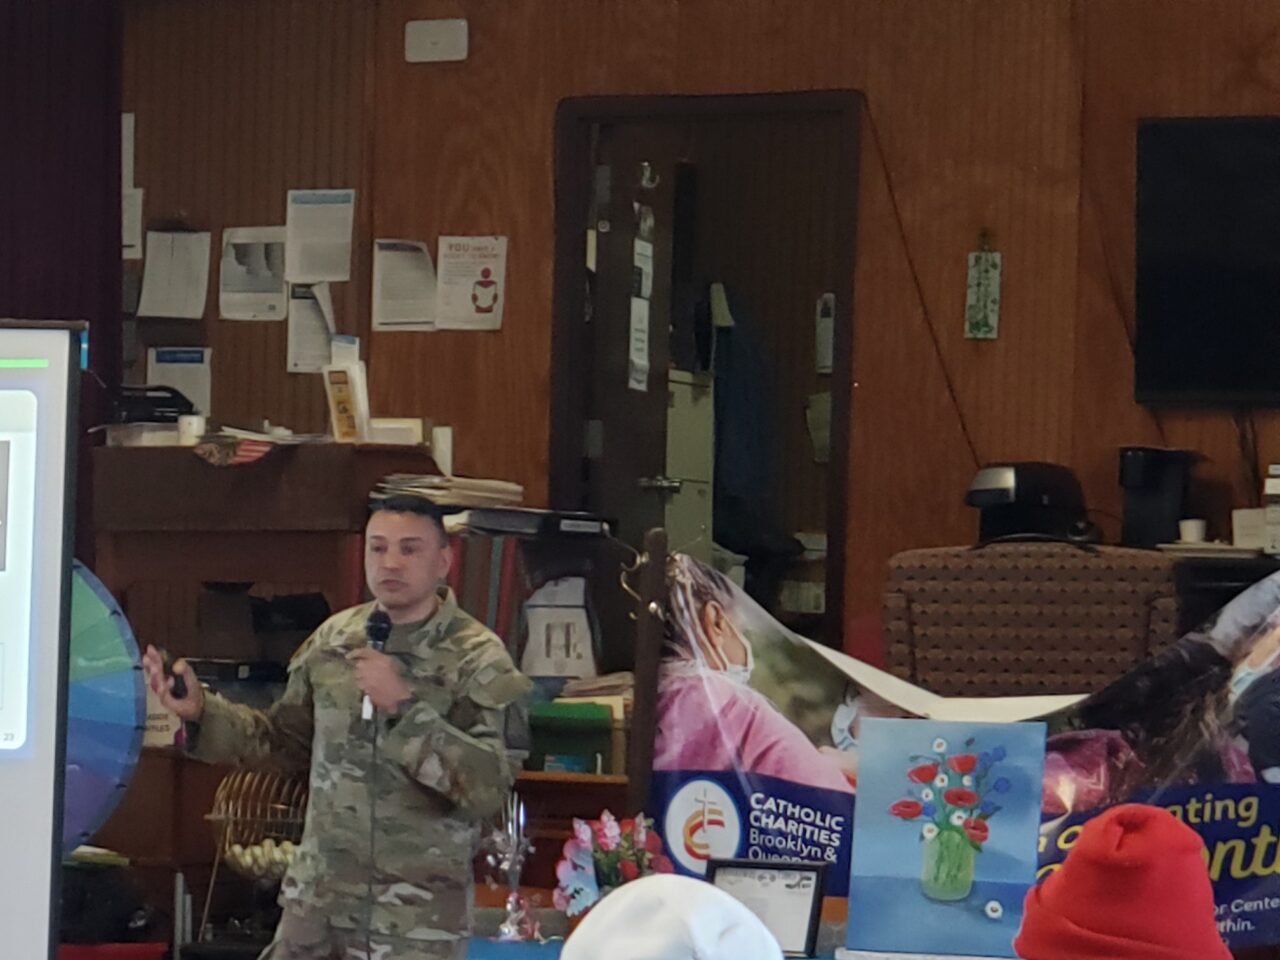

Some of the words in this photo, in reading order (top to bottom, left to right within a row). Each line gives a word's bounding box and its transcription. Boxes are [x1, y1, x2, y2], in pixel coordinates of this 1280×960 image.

[749, 811, 841, 847] CHARITIES
[750, 793, 844, 831] CATHOLIC
[748, 846, 810, 862] Queen
[750, 828, 821, 858] Brooklyn
[823, 846, 837, 863] &
